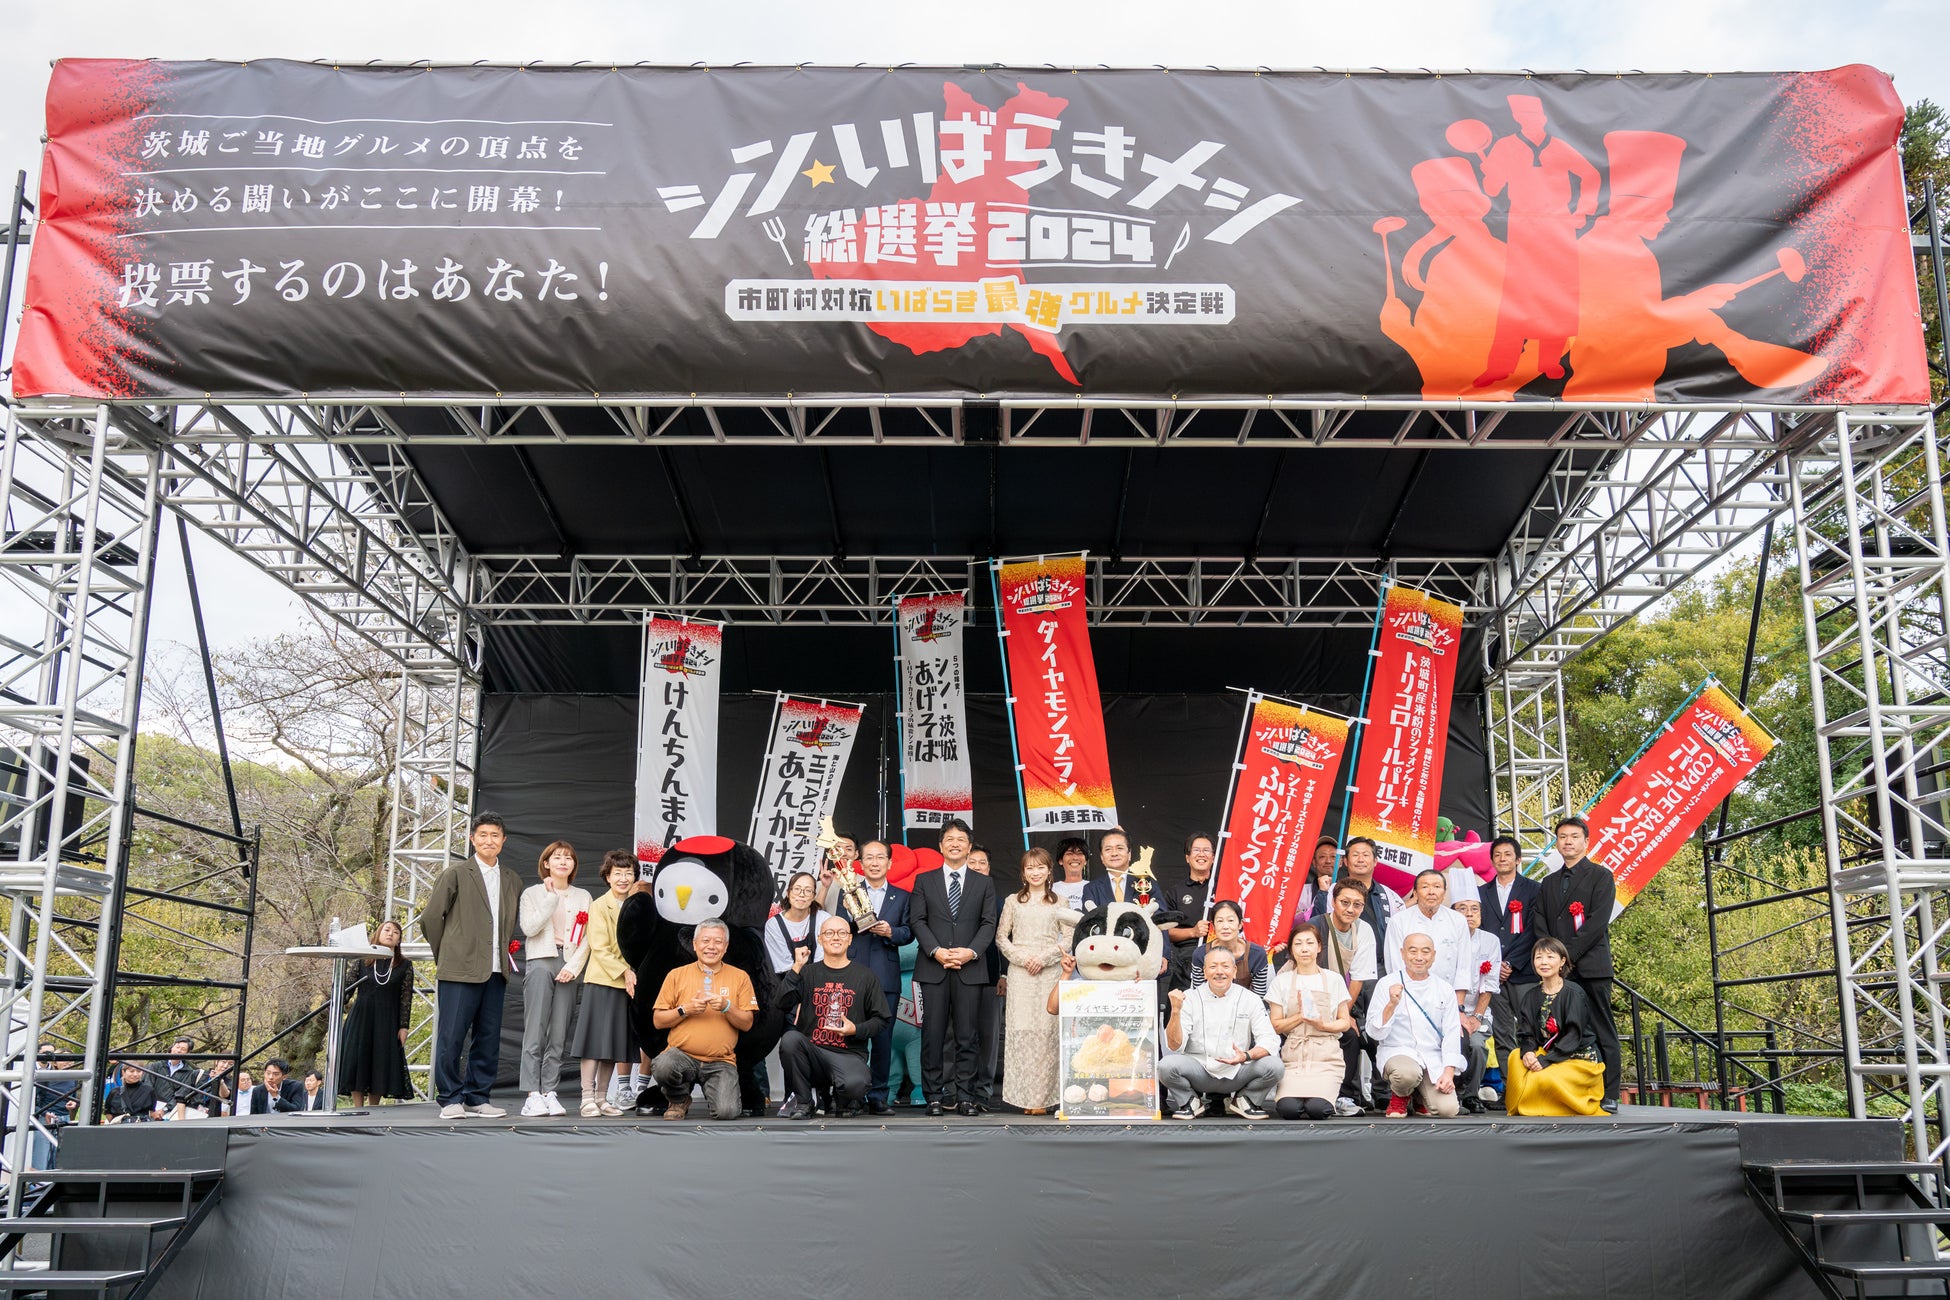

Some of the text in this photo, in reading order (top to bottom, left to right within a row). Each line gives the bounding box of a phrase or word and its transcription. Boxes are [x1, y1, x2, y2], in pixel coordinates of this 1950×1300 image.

[141, 129, 584, 161] 茨城ご当地グルメの頂点を
[117, 258, 610, 308] 投票するのはあなた！
[915, 660, 940, 762] あげそば
[1037, 620, 1077, 797] ダイヤモンブラン
[1376, 651, 1417, 832] トリコロールパルフェ
[1045, 809, 1105, 825] 小美玉市
[1238, 766, 1286, 940] ふわとろタル
[1261, 774, 1301, 889] シェーブルチーズの
[1600, 753, 1714, 872] COPA DE BASCHE
